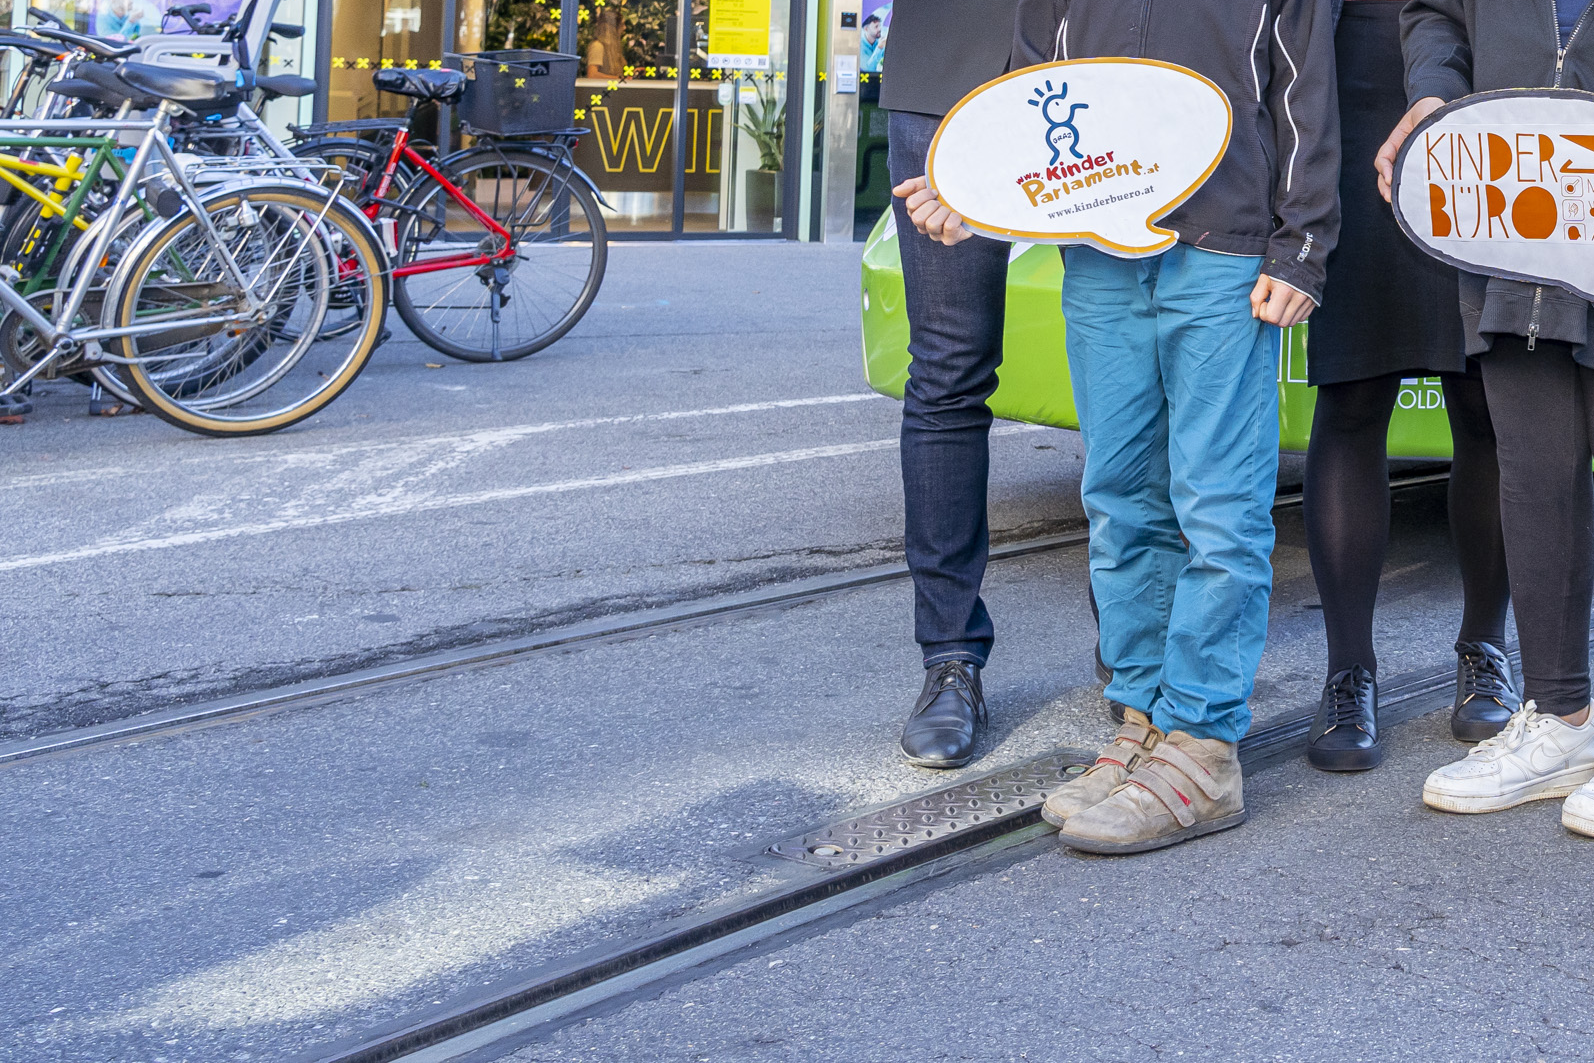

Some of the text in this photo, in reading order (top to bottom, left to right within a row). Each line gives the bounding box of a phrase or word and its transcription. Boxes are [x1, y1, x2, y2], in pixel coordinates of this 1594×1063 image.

[1425, 132, 1558, 183] KINDER
[1047, 185, 1155, 220] www.kinderbuero.at
[1428, 183, 1558, 240] BÜRO
